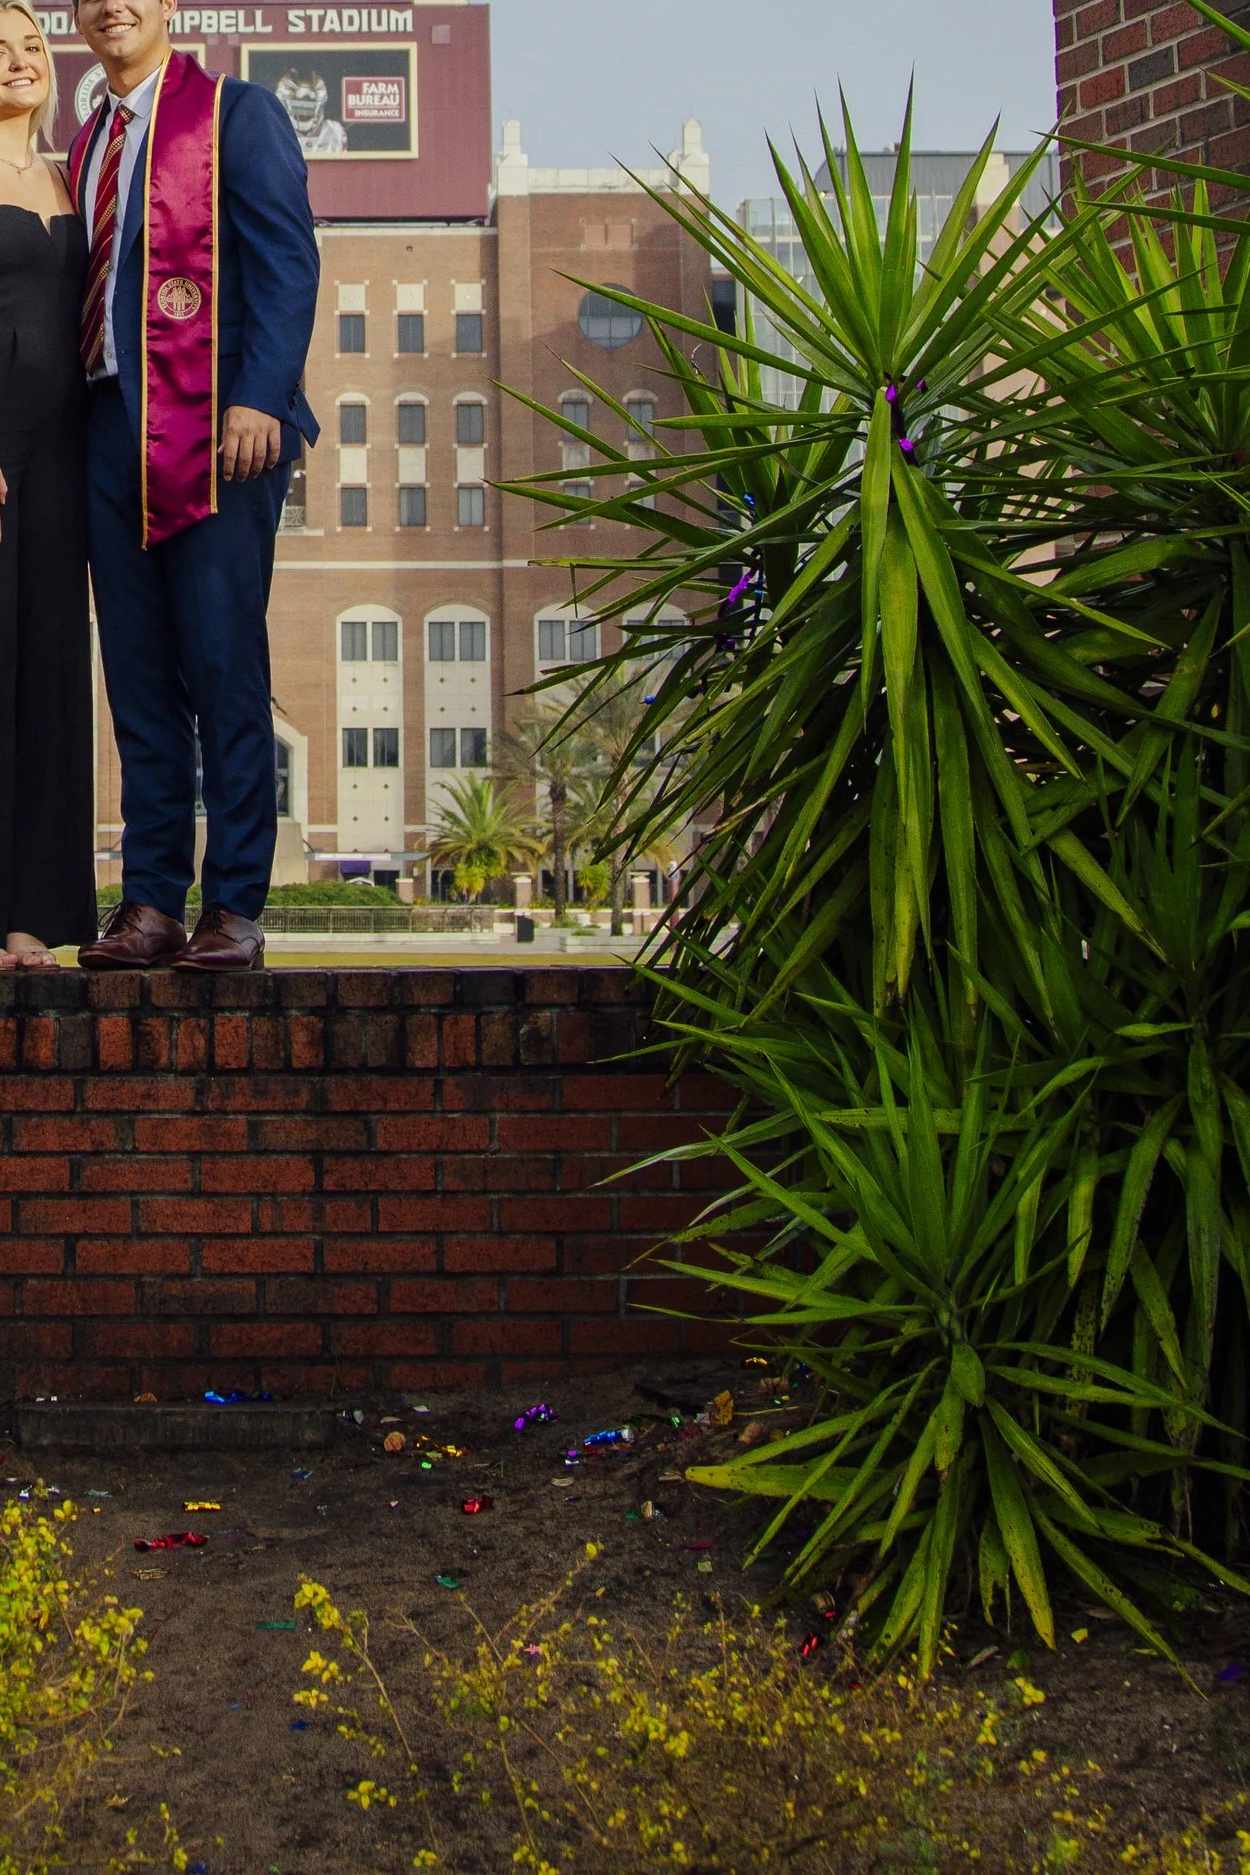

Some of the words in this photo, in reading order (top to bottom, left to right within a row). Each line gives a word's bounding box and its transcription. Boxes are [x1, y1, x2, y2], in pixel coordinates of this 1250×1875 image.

[168, 9, 272, 33] MPBELL
[287, 9, 414, 33] STADIUM
[362, 82, 399, 94] FARM
[348, 94, 400, 105] BUREAU
[354, 109, 400, 117] INSURANCE
